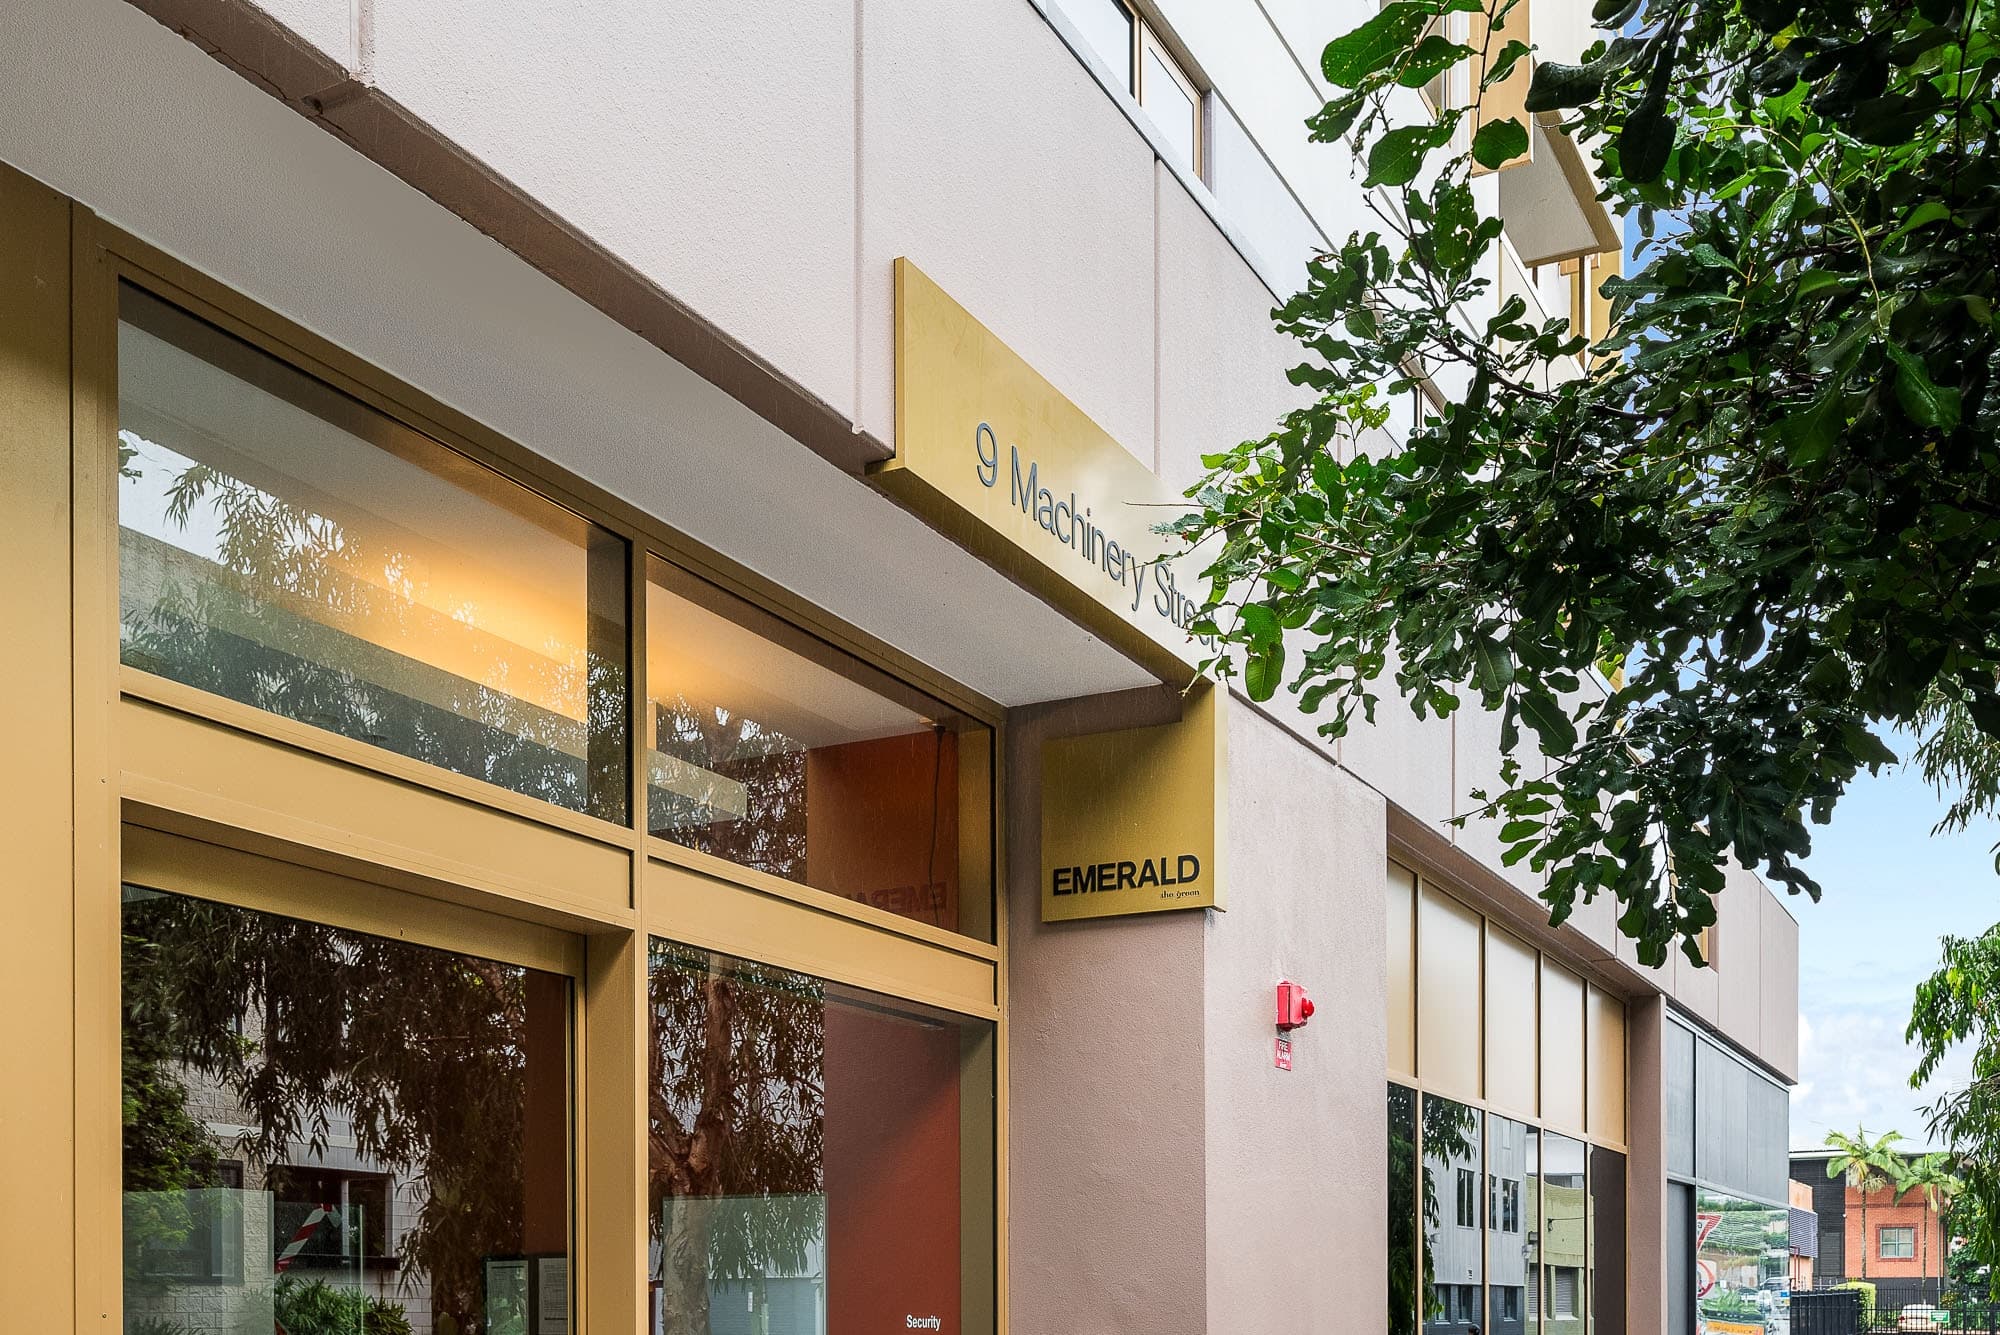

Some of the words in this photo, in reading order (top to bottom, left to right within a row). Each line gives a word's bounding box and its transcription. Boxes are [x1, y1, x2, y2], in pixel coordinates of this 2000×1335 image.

[976, 422, 998, 488] 9
[1011, 445, 1146, 612] Machinery
[1053, 854, 1200, 896] EMERALD
[906, 1314, 941, 1332] Security
